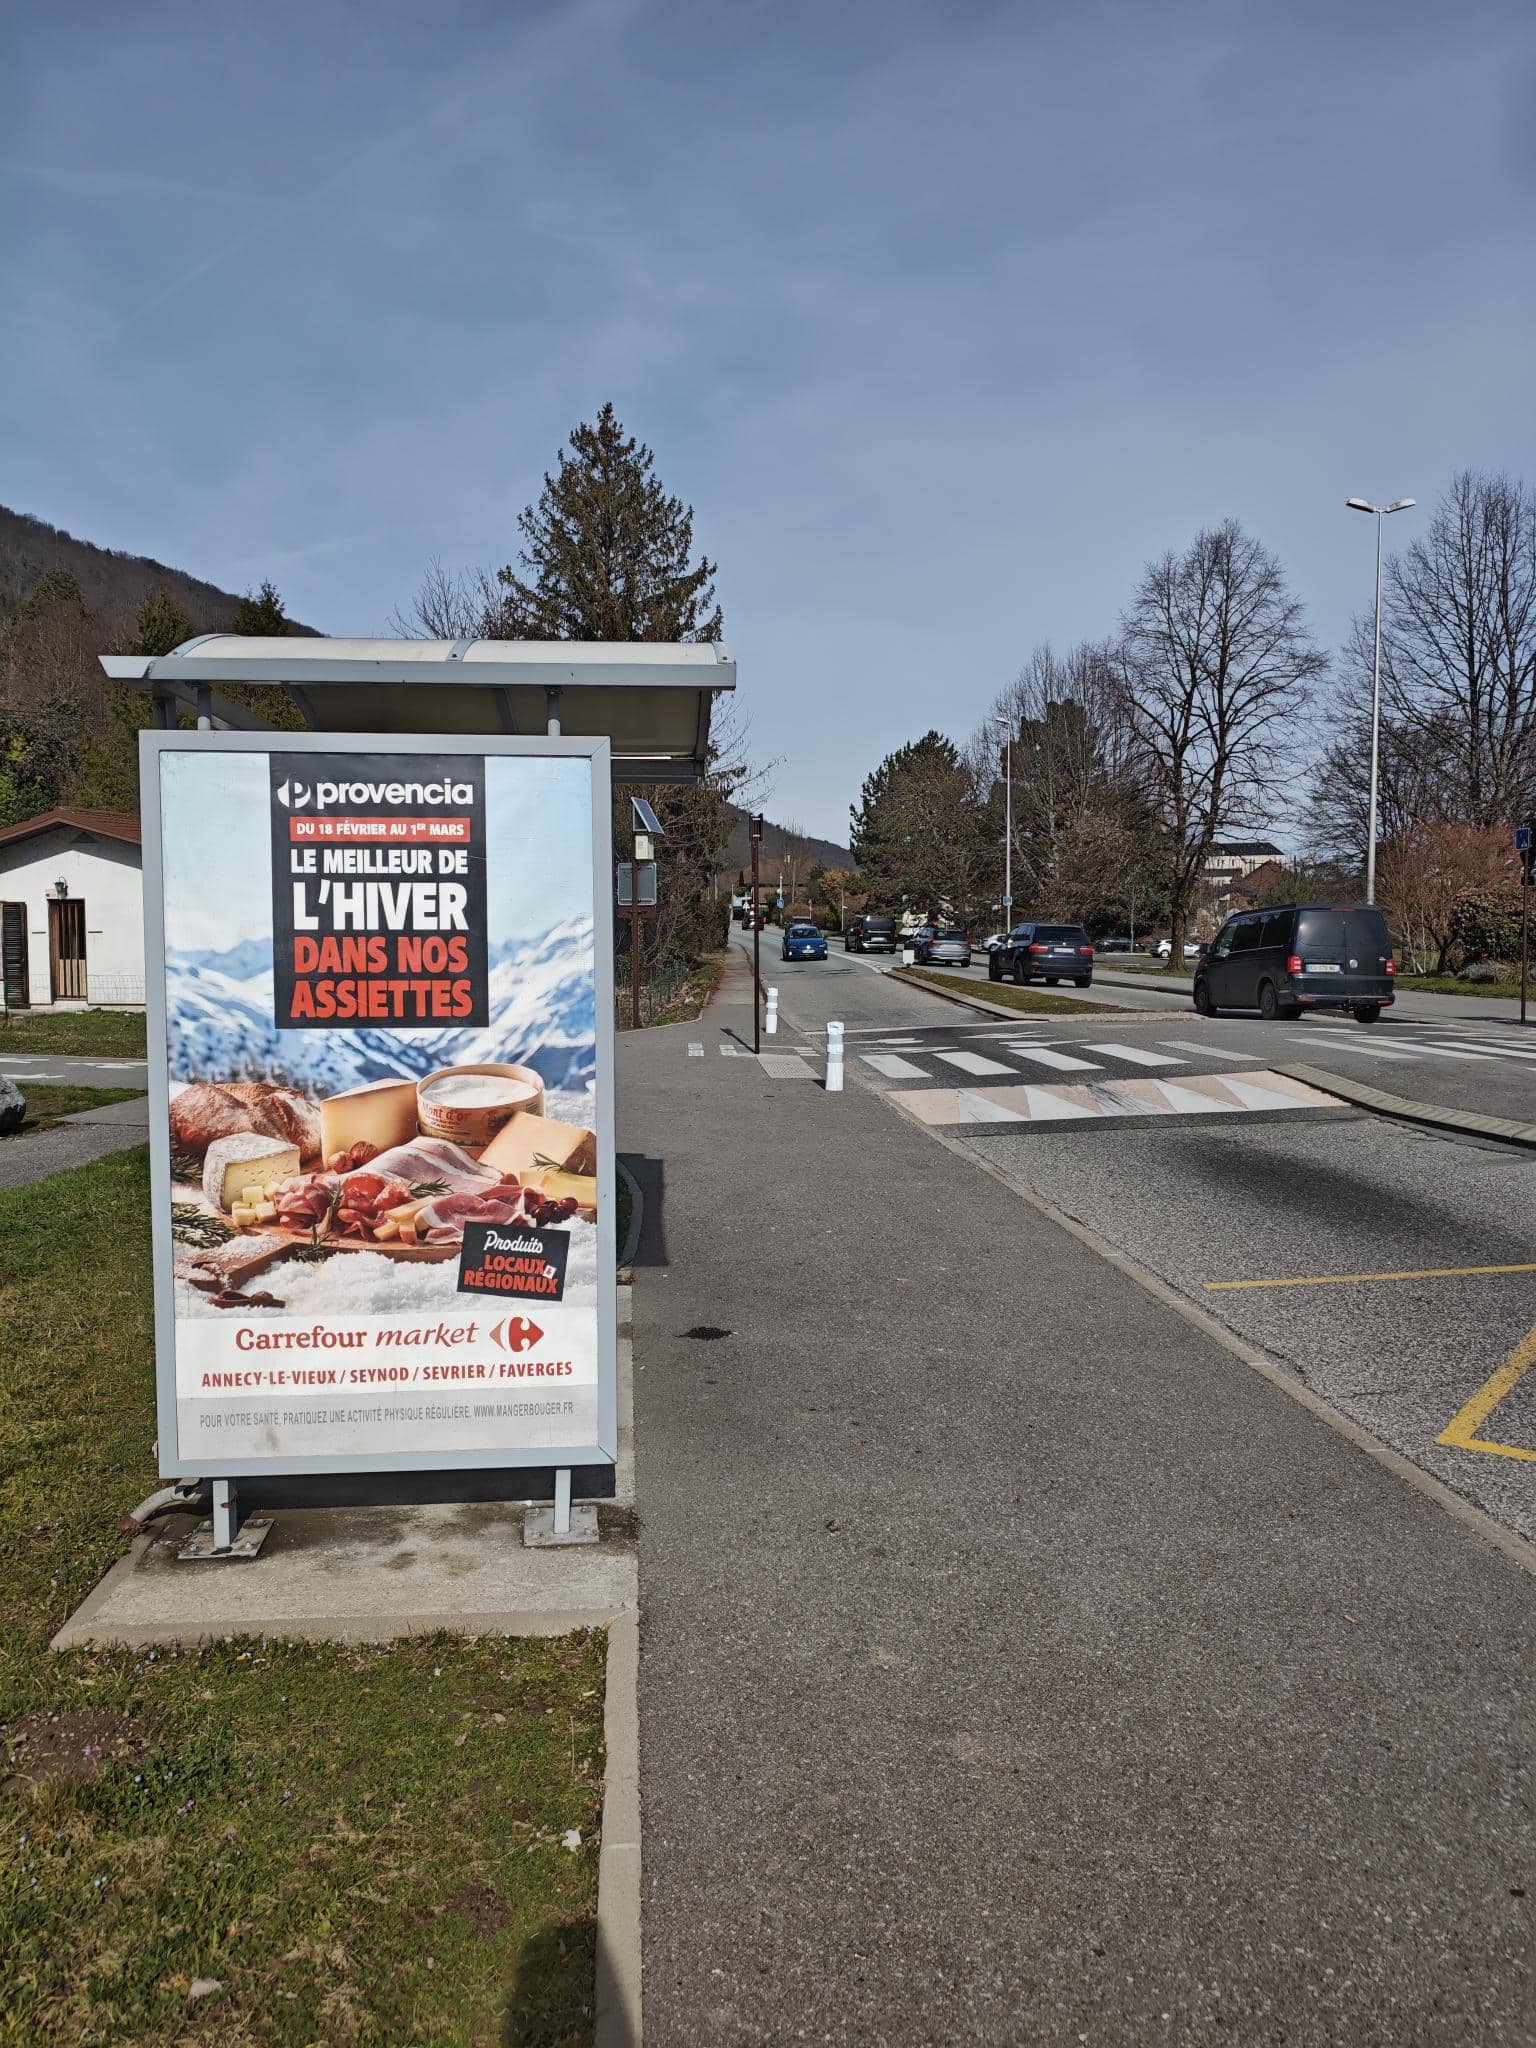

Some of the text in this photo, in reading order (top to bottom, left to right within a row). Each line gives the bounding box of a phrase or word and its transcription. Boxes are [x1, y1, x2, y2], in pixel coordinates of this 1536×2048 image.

[316, 778, 474, 810] provencia
[296, 823, 315, 835] DU
[318, 823, 333, 835] 18
[336, 820, 386, 836] FÉVRIER
[389, 824, 407, 836] AU
[429, 824, 464, 836] MARS
[291, 848, 469, 875] LE MEILLEUR DE
[293, 879, 470, 931] L'HIVER
[294, 936, 469, 974] DANS NOS
[290, 979, 473, 1019] ASSIETTES
[483, 1230, 544, 1254] Produits
[484, 1254, 546, 1275] LOCAUX
[463, 1268, 559, 1294] RÉGIONAUX
[236, 1321, 480, 1351] Carrefour market
[202, 1369, 337, 1387] ANNECY-LE-VIEUX
[350, 1366, 409, 1383] SEYNOD
[423, 1364, 486, 1380] SEVRIER
[500, 1361, 573, 1378] FAVERGES
[199, 1414, 222, 1428] POUR
[224, 1412, 252, 1426] VOTRE
[283, 1410, 328, 1425] PRATIQUEZ
[329, 1409, 346, 1422] UNE
[347, 1405, 383, 1422] ACTIVITÉ
[384, 1407, 424, 1421] PHYSIQUE
[473, 1401, 575, 1417] WWW.MANGERBOUGER.FR
